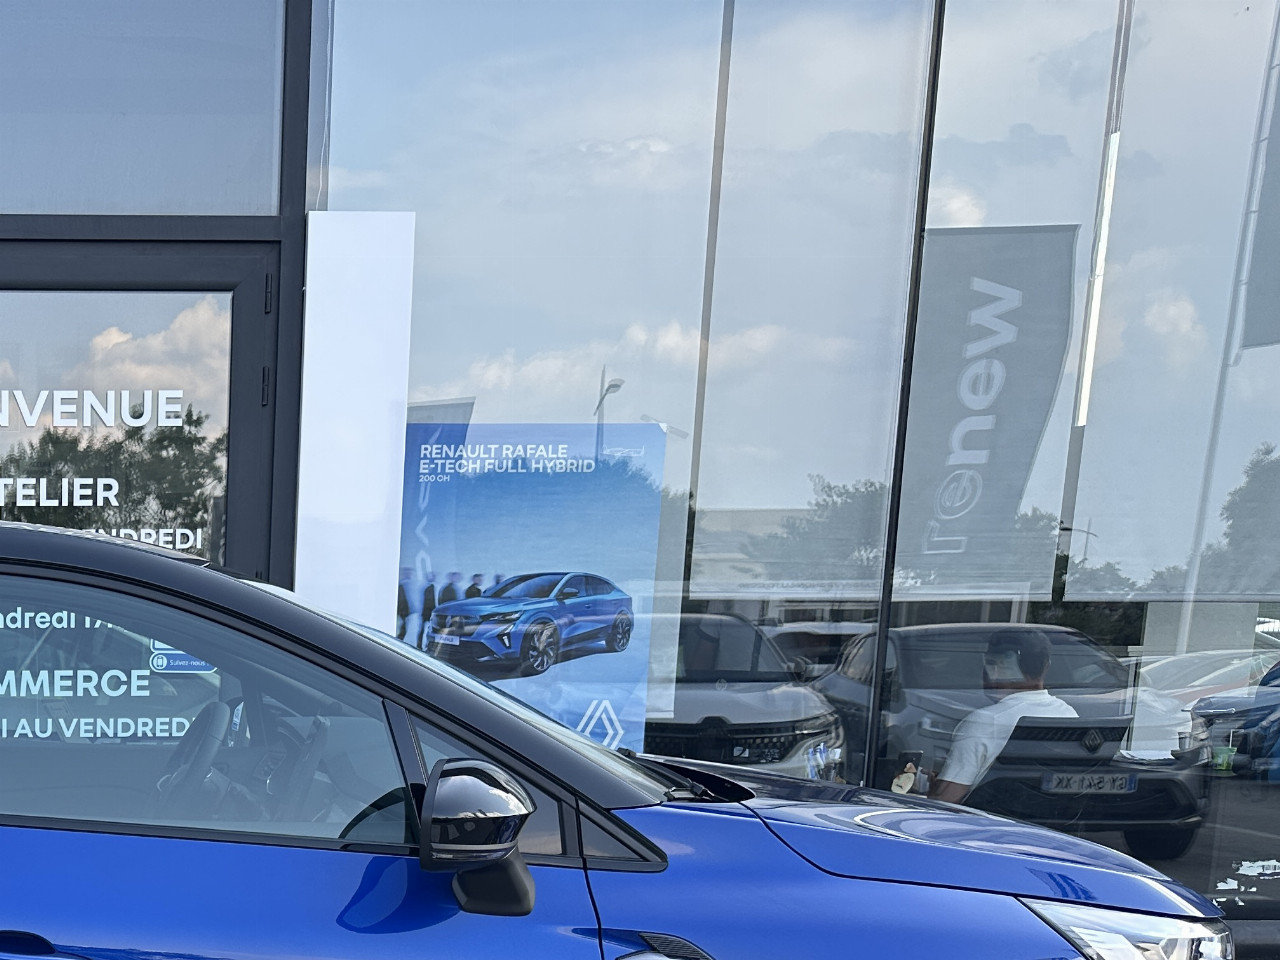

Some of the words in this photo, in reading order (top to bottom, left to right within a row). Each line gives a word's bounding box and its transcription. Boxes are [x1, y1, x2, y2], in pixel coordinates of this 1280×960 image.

[923, 277, 1022, 556] renew
[420, 444, 500, 458] RENAULT
[502, 444, 568, 458] RAFALE
[419, 459, 481, 473] E-TECH
[484, 459, 527, 473] FULL
[531, 459, 596, 473] HYBRID
[14, 718, 53, 738] AU
[59, 717, 195, 738] VENDRED
